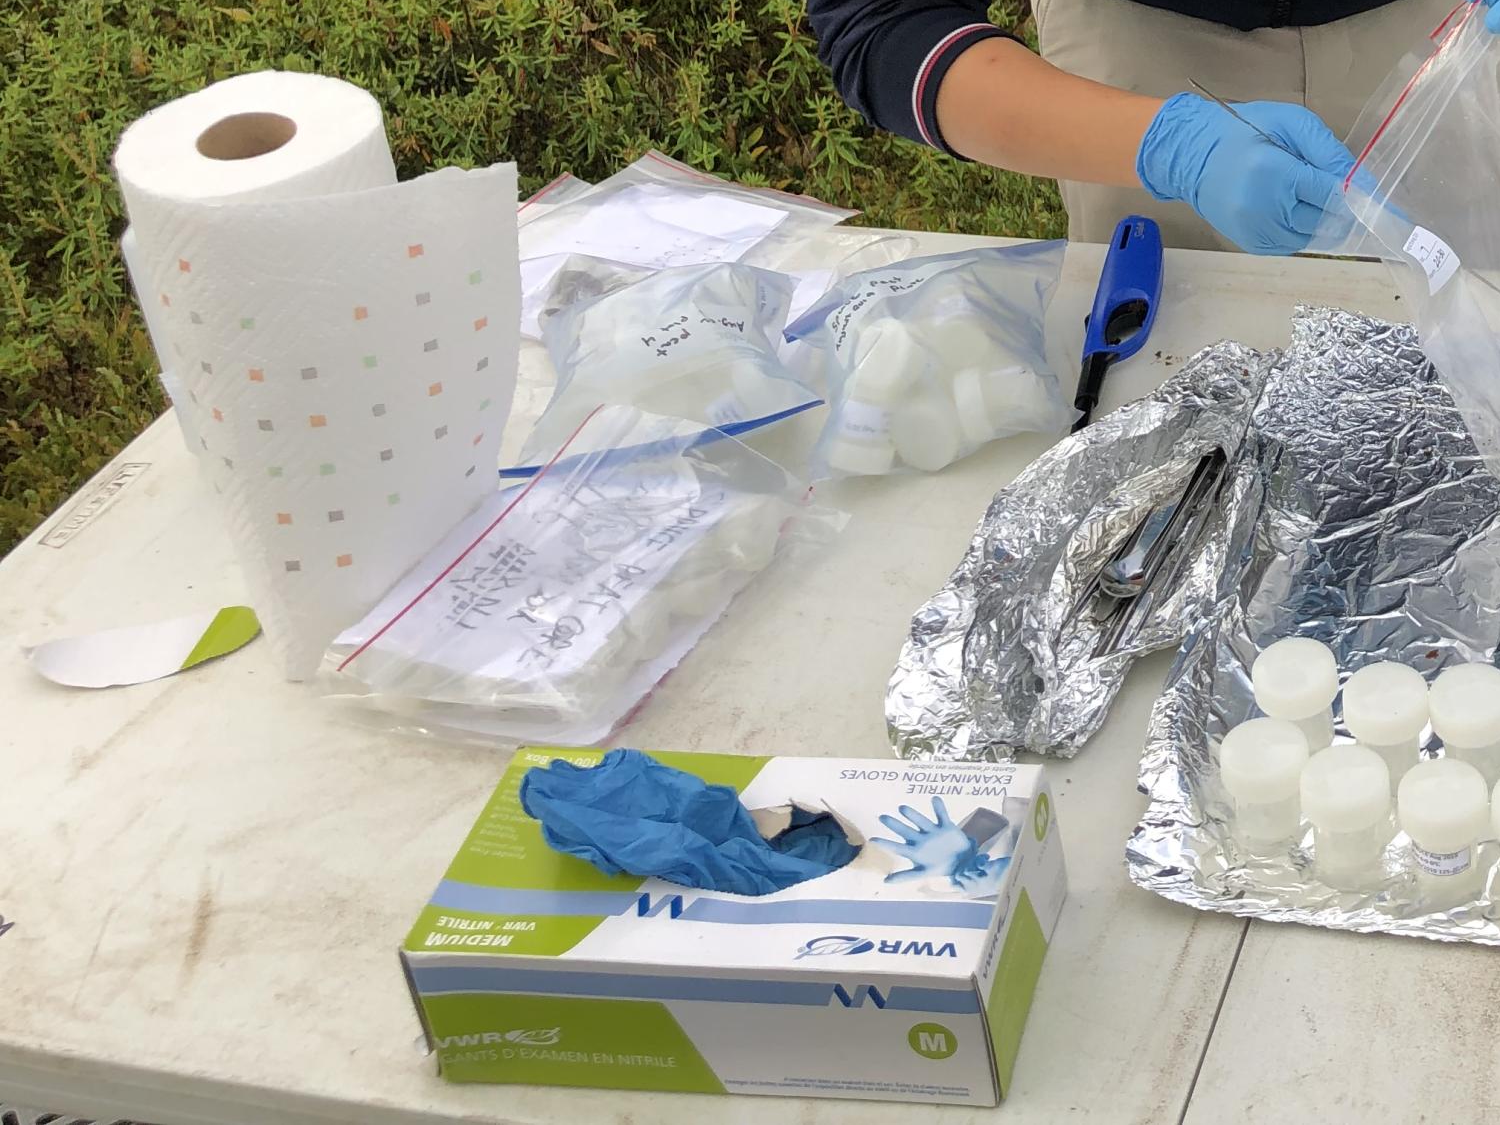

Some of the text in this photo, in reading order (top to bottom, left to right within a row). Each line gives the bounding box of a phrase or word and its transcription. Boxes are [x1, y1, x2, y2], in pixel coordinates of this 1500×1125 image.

[525, 753, 550, 765] Box
[839, 769, 1013, 785] EXAMINATION GLOVES
[906, 784, 964, 795] NITRILE
[436, 915, 494, 930] NITRILE
[424, 932, 514, 947] MEDIUM
[878, 940, 957, 958] VWR
[434, 1032, 502, 1048] VWR
[918, 1032, 947, 1052] M
[442, 1048, 677, 1068] GANTS D'EXAMEN EN NITRILE
